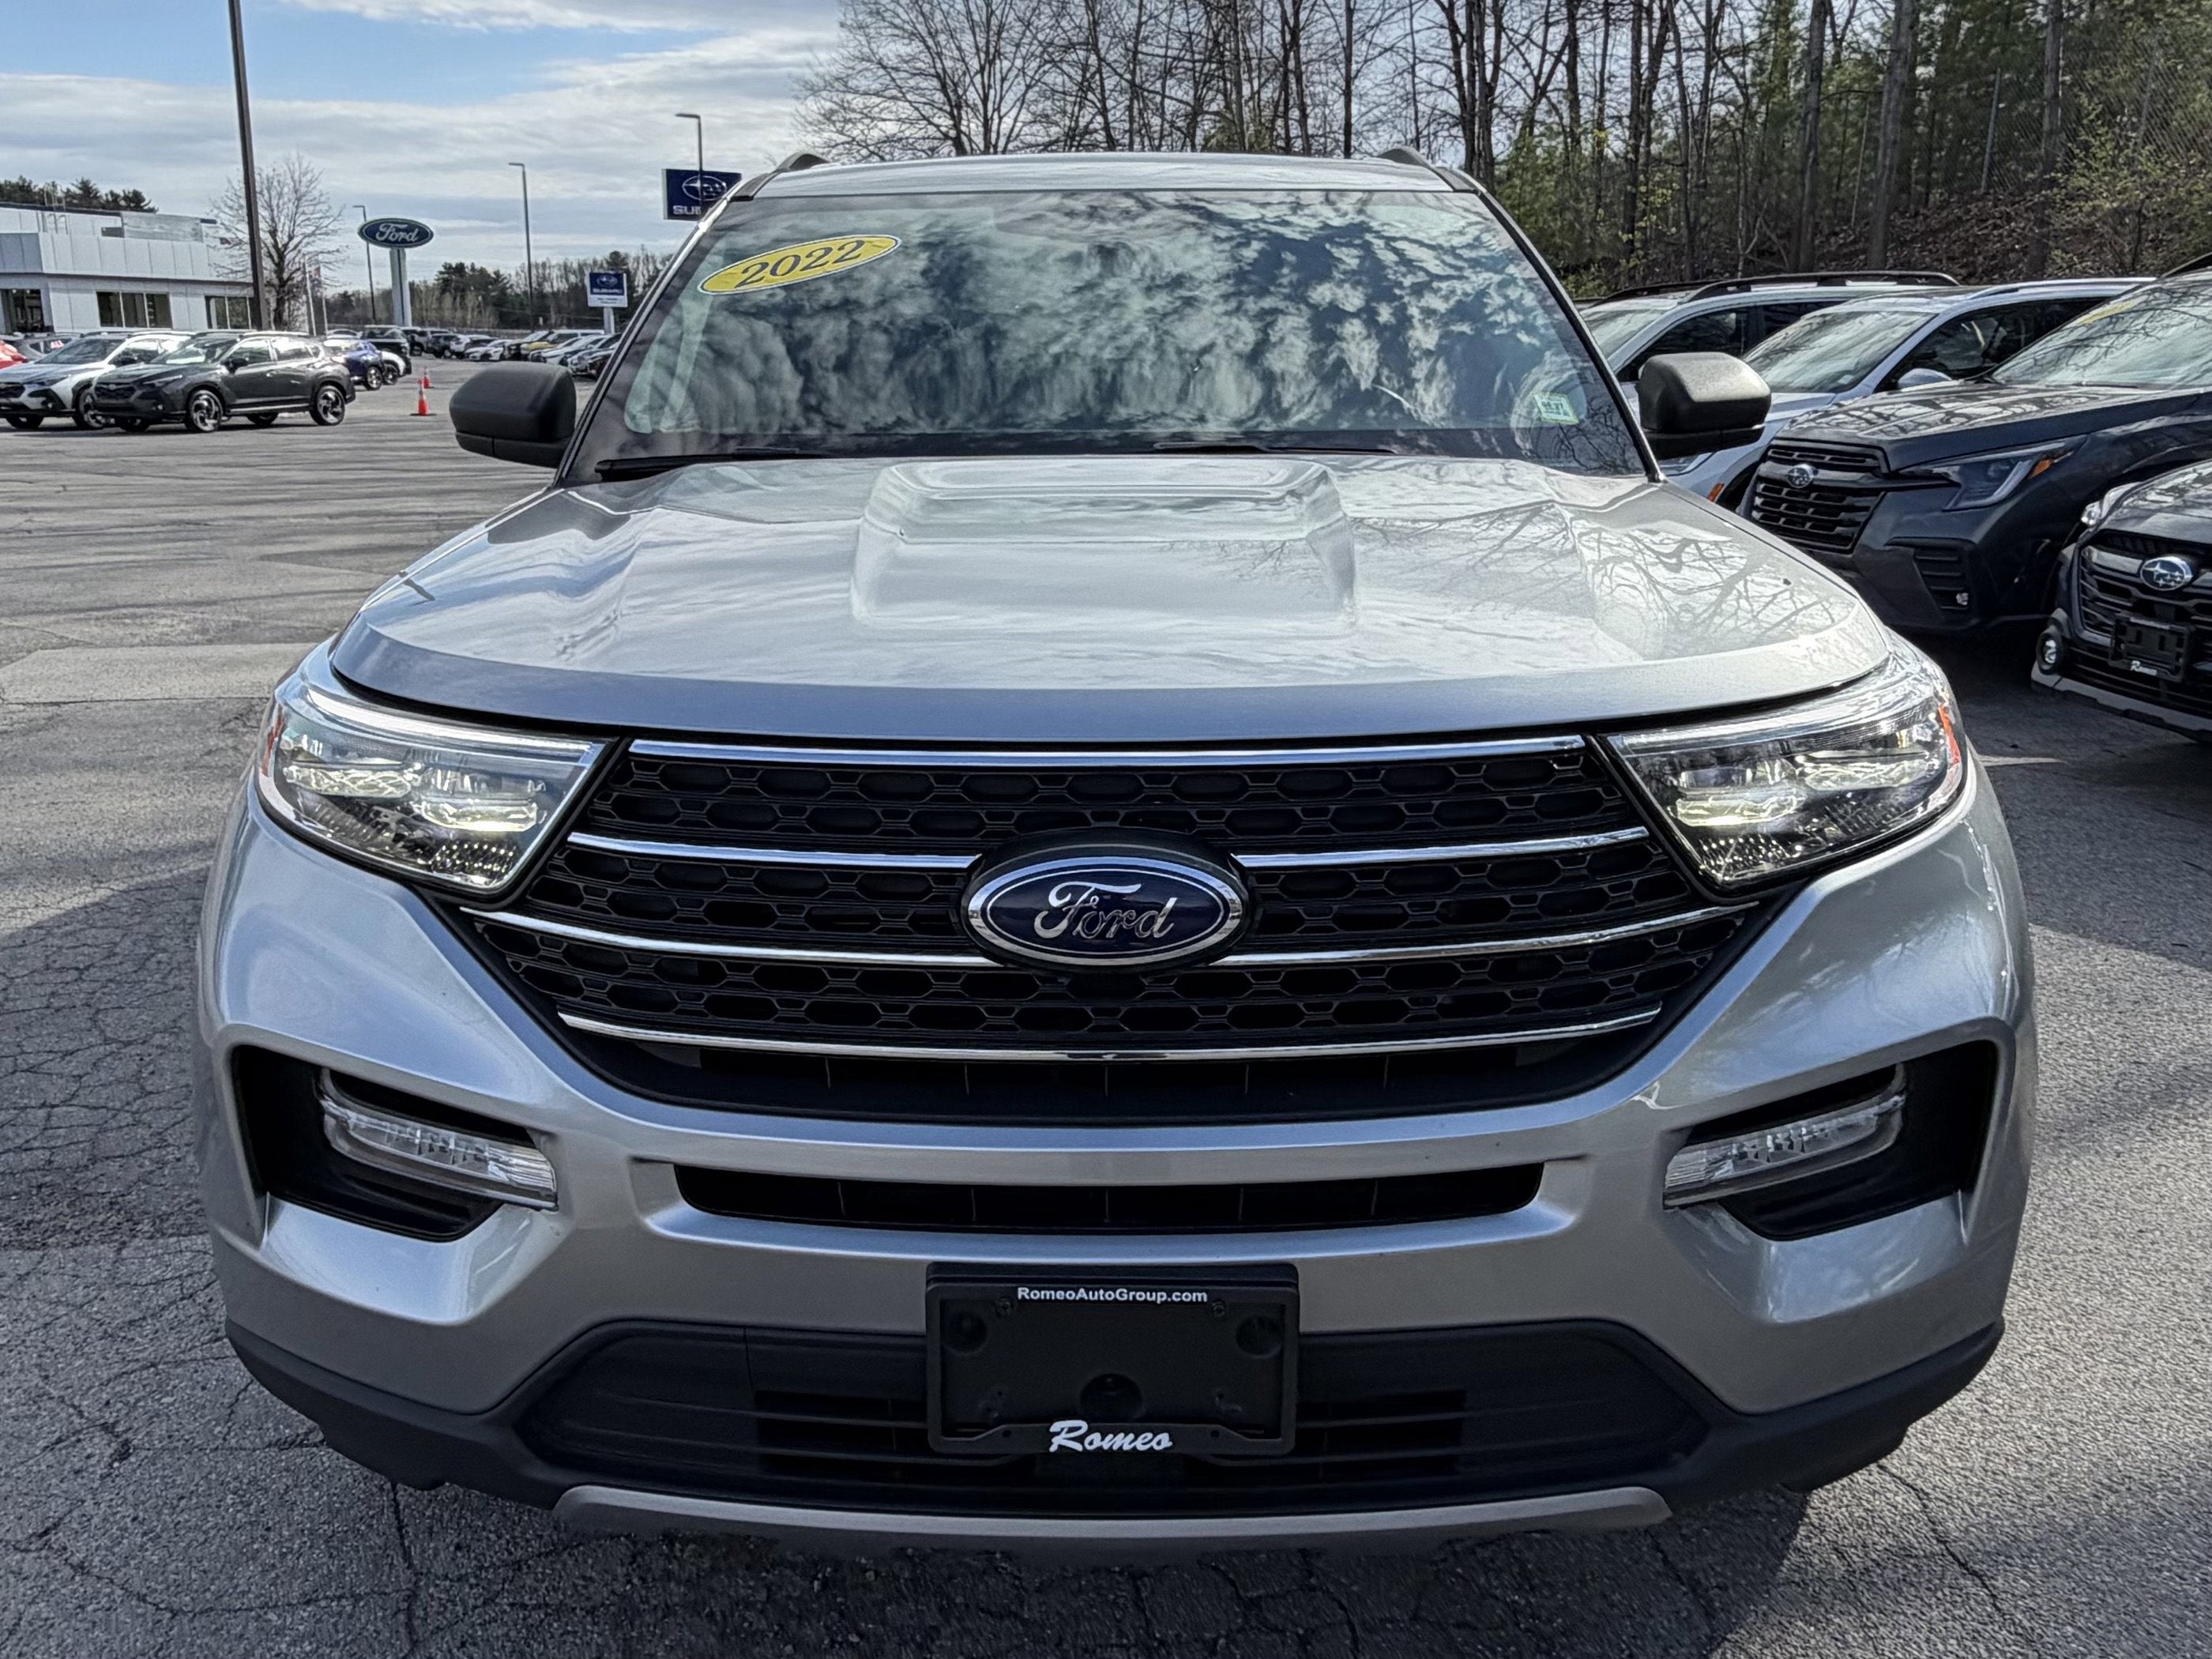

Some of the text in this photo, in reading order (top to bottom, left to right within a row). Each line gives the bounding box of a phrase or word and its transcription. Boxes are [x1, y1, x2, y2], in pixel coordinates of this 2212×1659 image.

[375, 223, 419, 242] Ford
[734, 239, 866, 288] 2022
[1033, 881, 1178, 939] Ford
[1018, 1287, 1208, 1304] RomeoAutoGroup.com
[1048, 1420, 1173, 1453] Romeo
